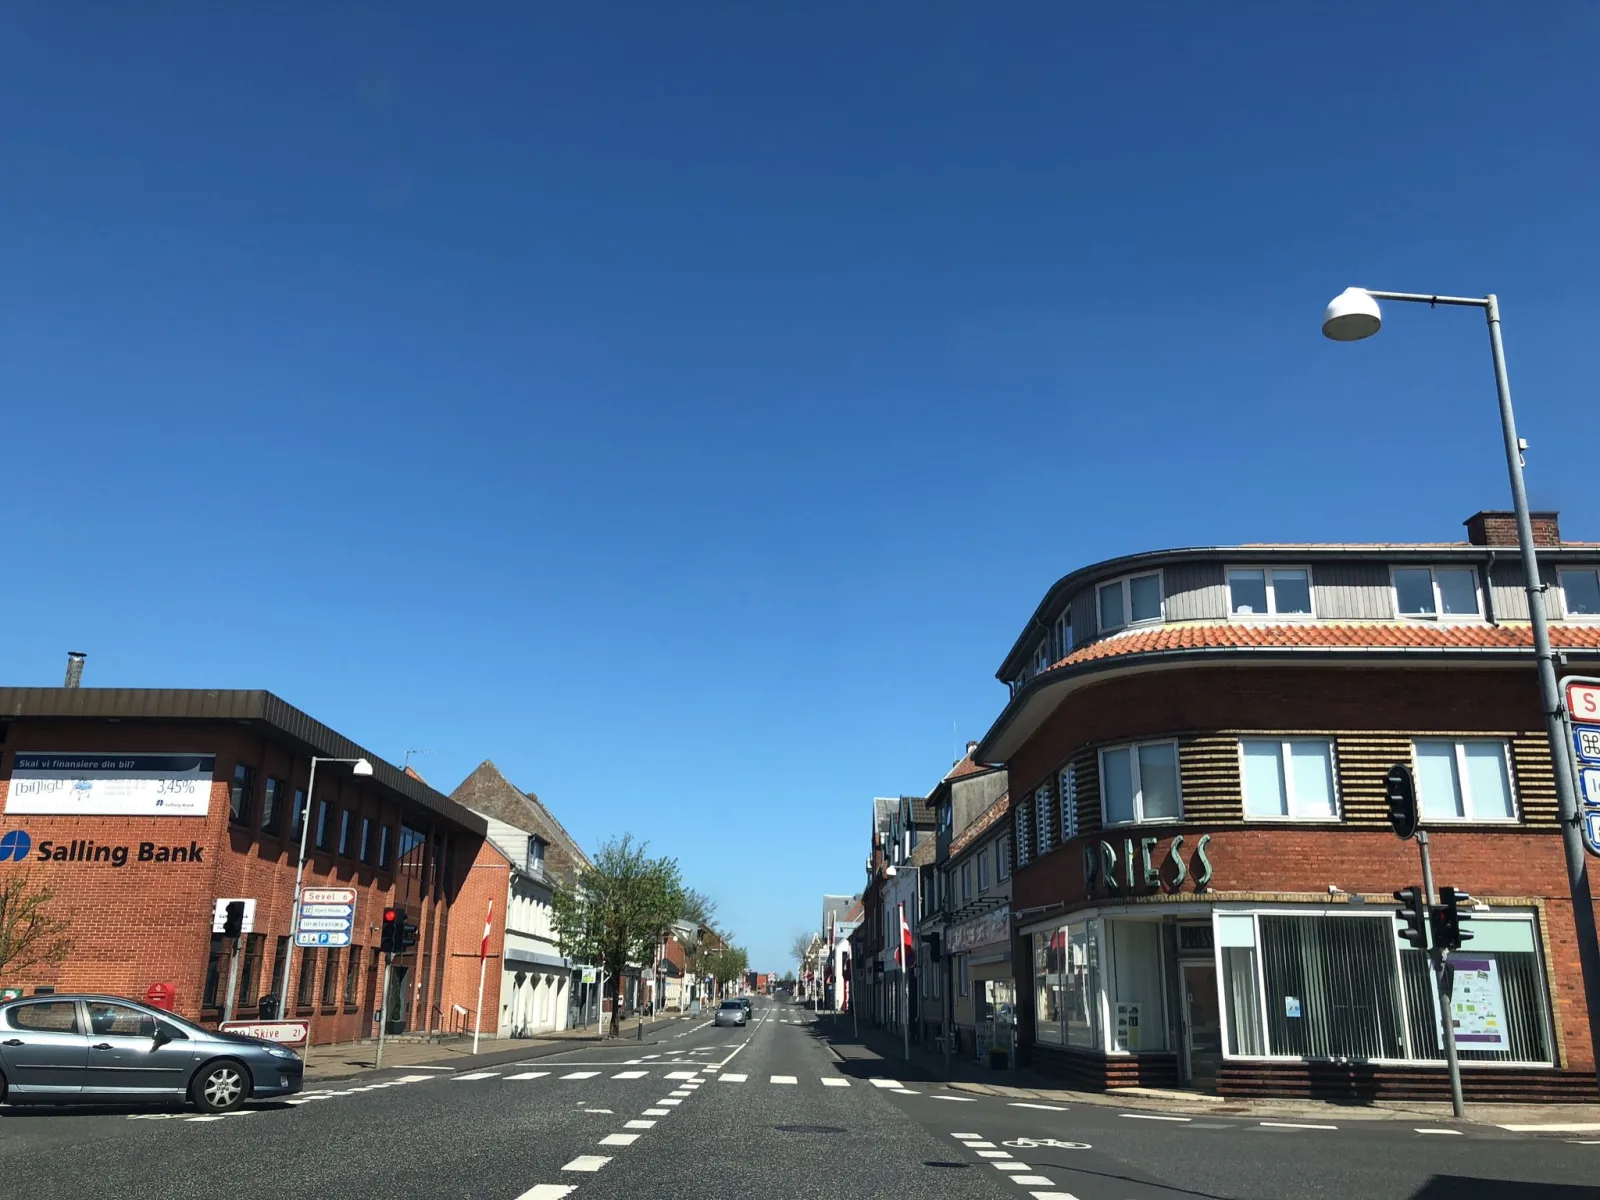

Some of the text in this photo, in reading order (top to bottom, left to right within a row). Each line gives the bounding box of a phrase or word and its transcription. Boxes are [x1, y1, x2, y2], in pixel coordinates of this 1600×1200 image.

[19, 760, 135, 769] Skal vi finansiere din bil?
[157, 779, 195, 795] 3,45%
[37, 840, 204, 867] Salling Bank
[254, 1028, 280, 1038] Skive
[293, 1028, 301, 1037] 21
